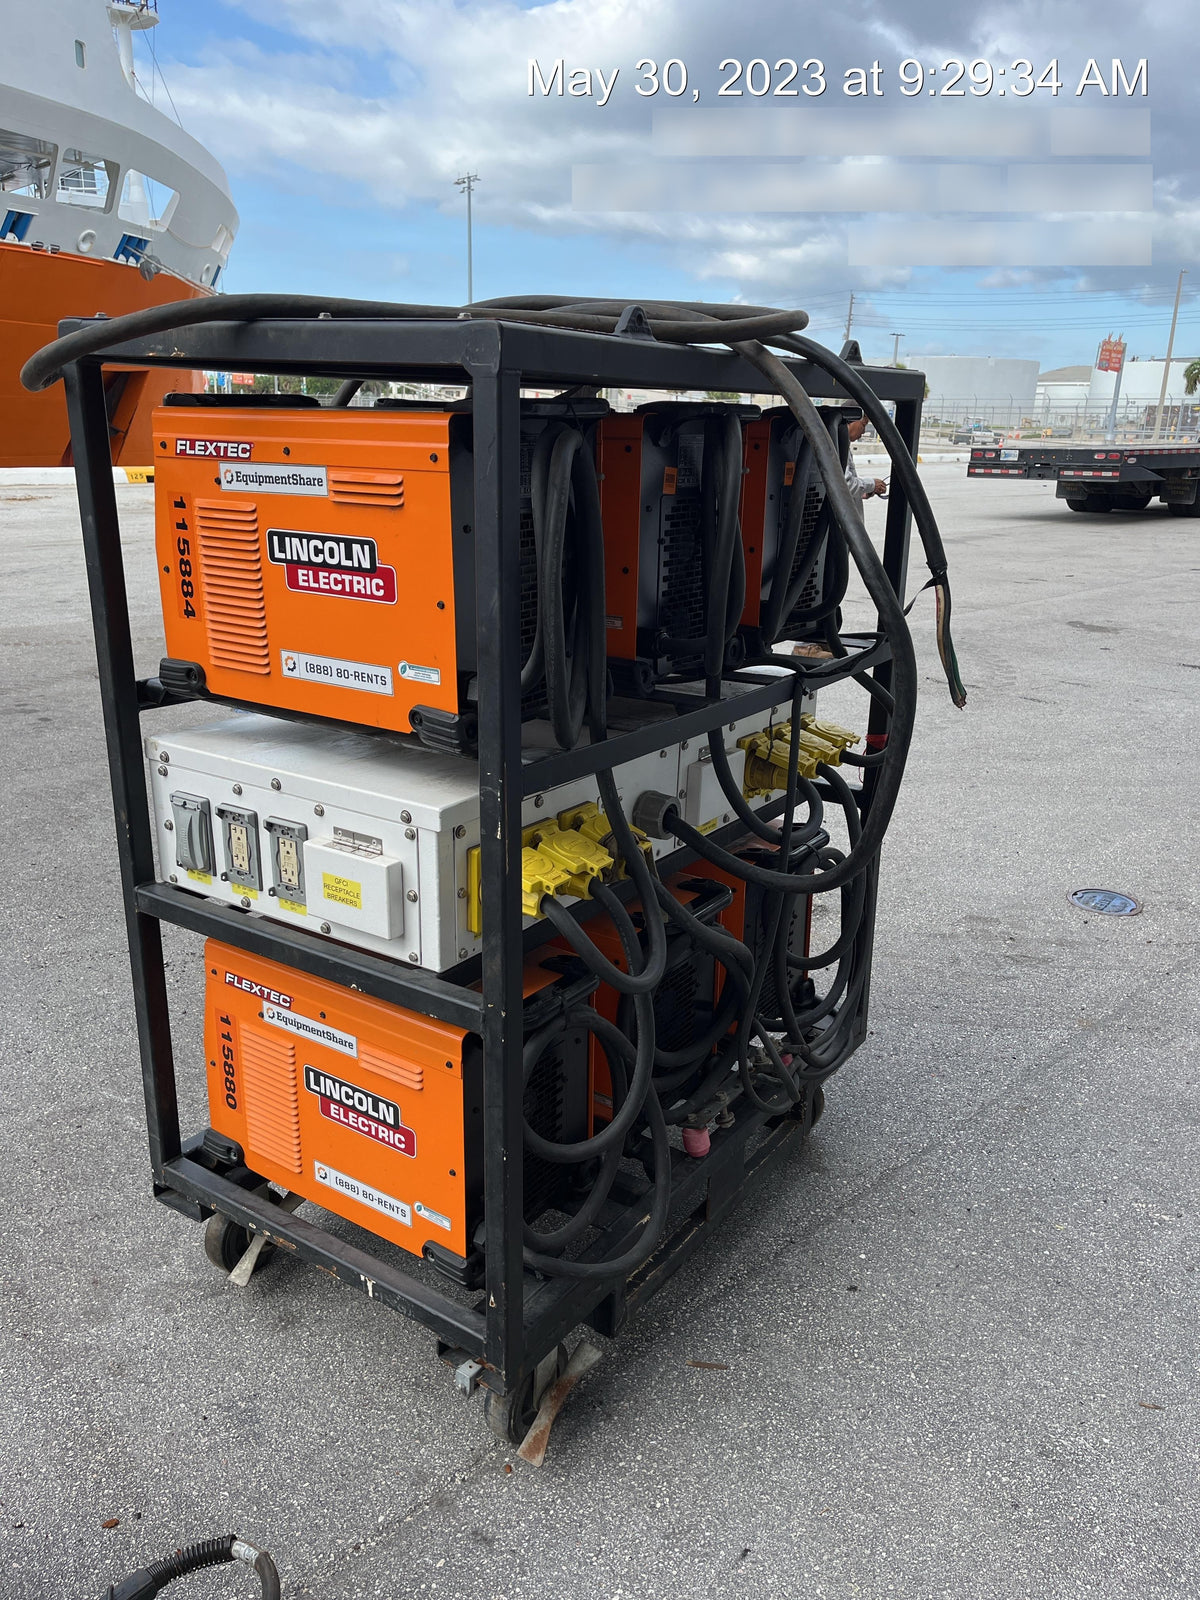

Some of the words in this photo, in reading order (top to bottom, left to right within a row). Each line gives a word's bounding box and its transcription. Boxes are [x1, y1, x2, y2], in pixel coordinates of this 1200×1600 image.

[176, 440, 251, 458] FLEXTEC
[234, 470, 324, 487] EquipmentShare
[173, 496, 197, 619] 115884
[272, 535, 371, 569] LINCOLN
[297, 568, 385, 597] ELECTRIC
[304, 660, 333, 677] (888)
[335, 666, 388, 687] 80-RENTS
[323, 882, 361, 900] RECEPTACLE
[334, 877, 349, 887] GFCI
[326, 892, 358, 908] BREAKERS
[225, 973, 291, 1007] FLEXTEC
[275, 1011, 355, 1051] EquipmentShare
[219, 1014, 238, 1110] 115880
[309, 1070, 395, 1125] LINCOLN
[330, 1102, 406, 1150] ELECTRIC
[334, 1175, 360, 1197] (888)
[361, 1185, 408, 1218] 80-RENTS
